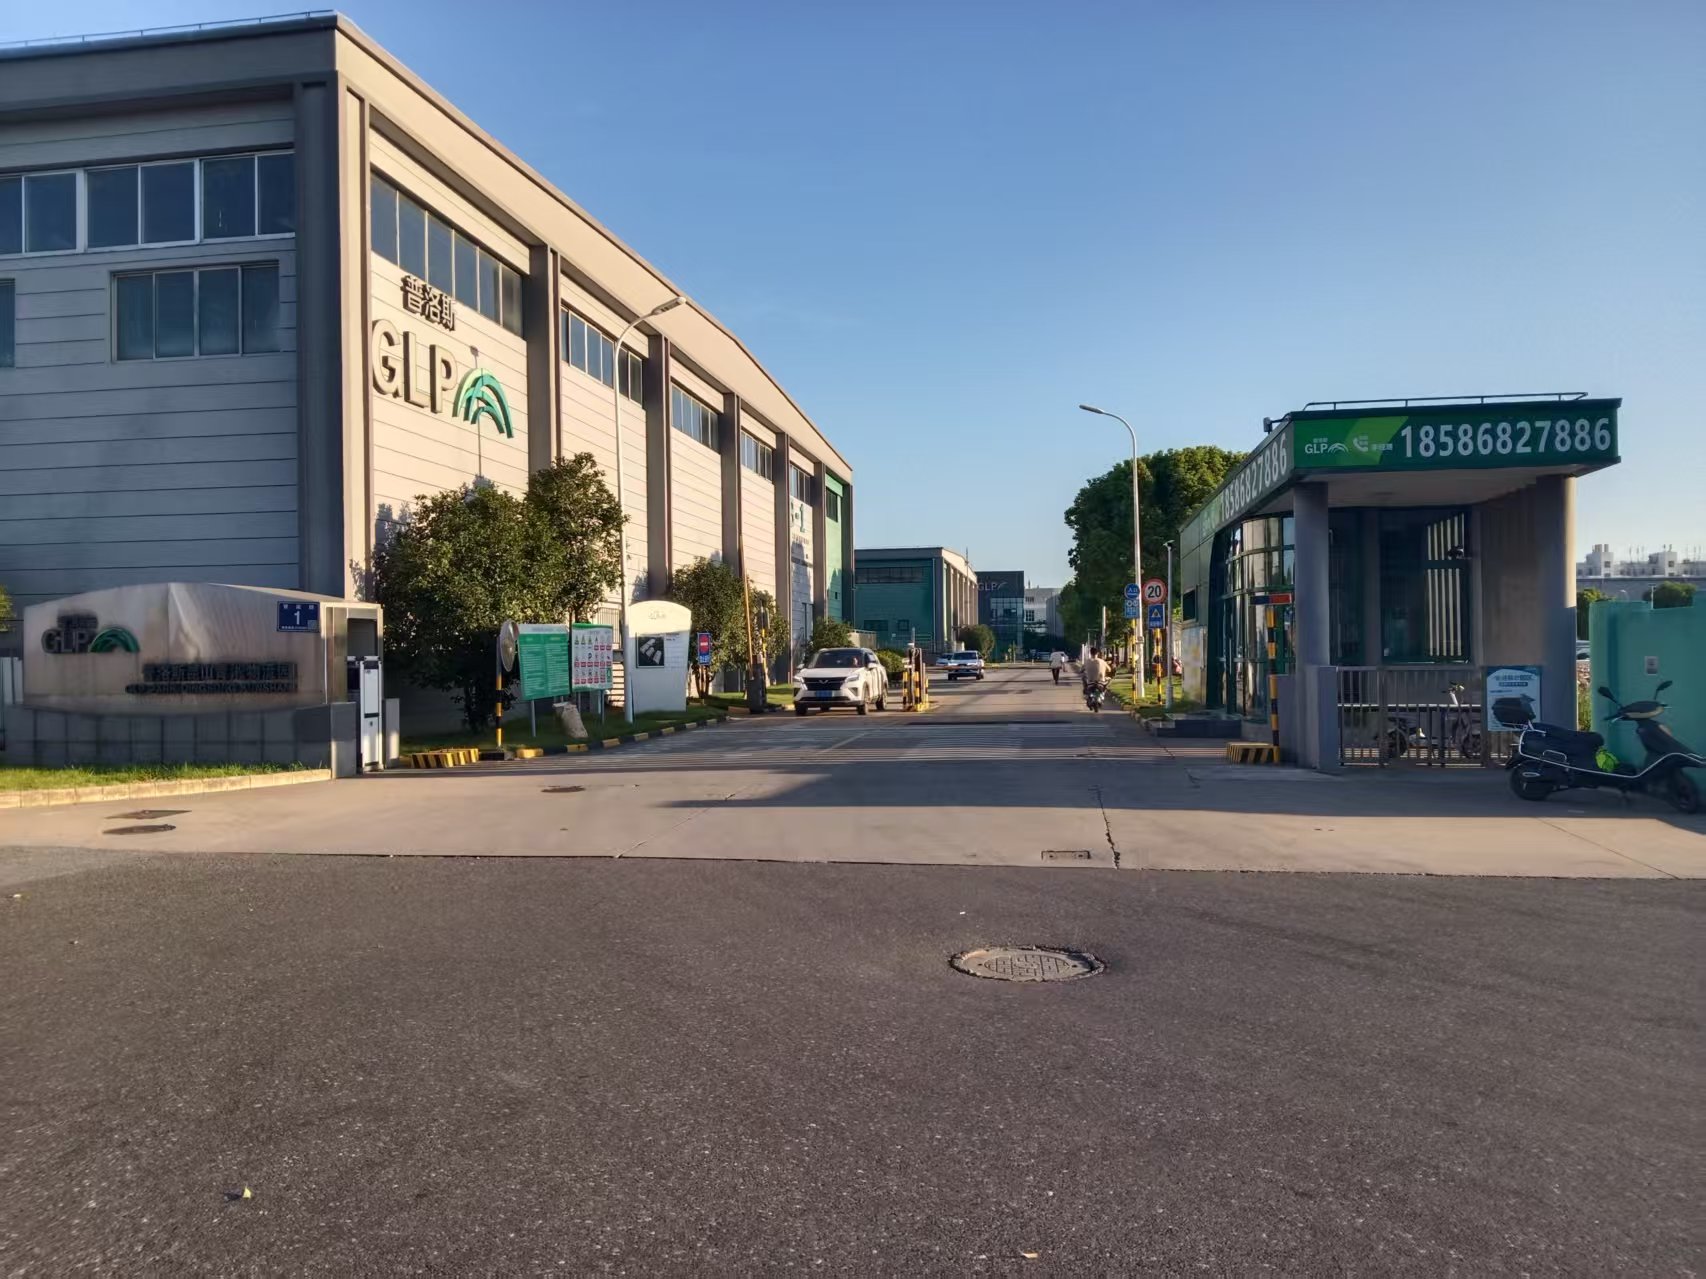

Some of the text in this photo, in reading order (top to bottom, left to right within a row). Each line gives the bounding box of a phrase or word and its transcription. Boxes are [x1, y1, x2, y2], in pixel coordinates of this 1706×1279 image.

[401, 275, 456, 331] 普洛斯
[373, 319, 459, 414] GLP
[1304, 443, 1329, 455] GLP
[1401, 417, 1611, 459] 18586827886
[1220, 433, 1287, 521] 18586827886
[1147, 585, 1161, 598] 20
[293, 611, 300, 625] 1
[41, 628, 90, 653] GLP
